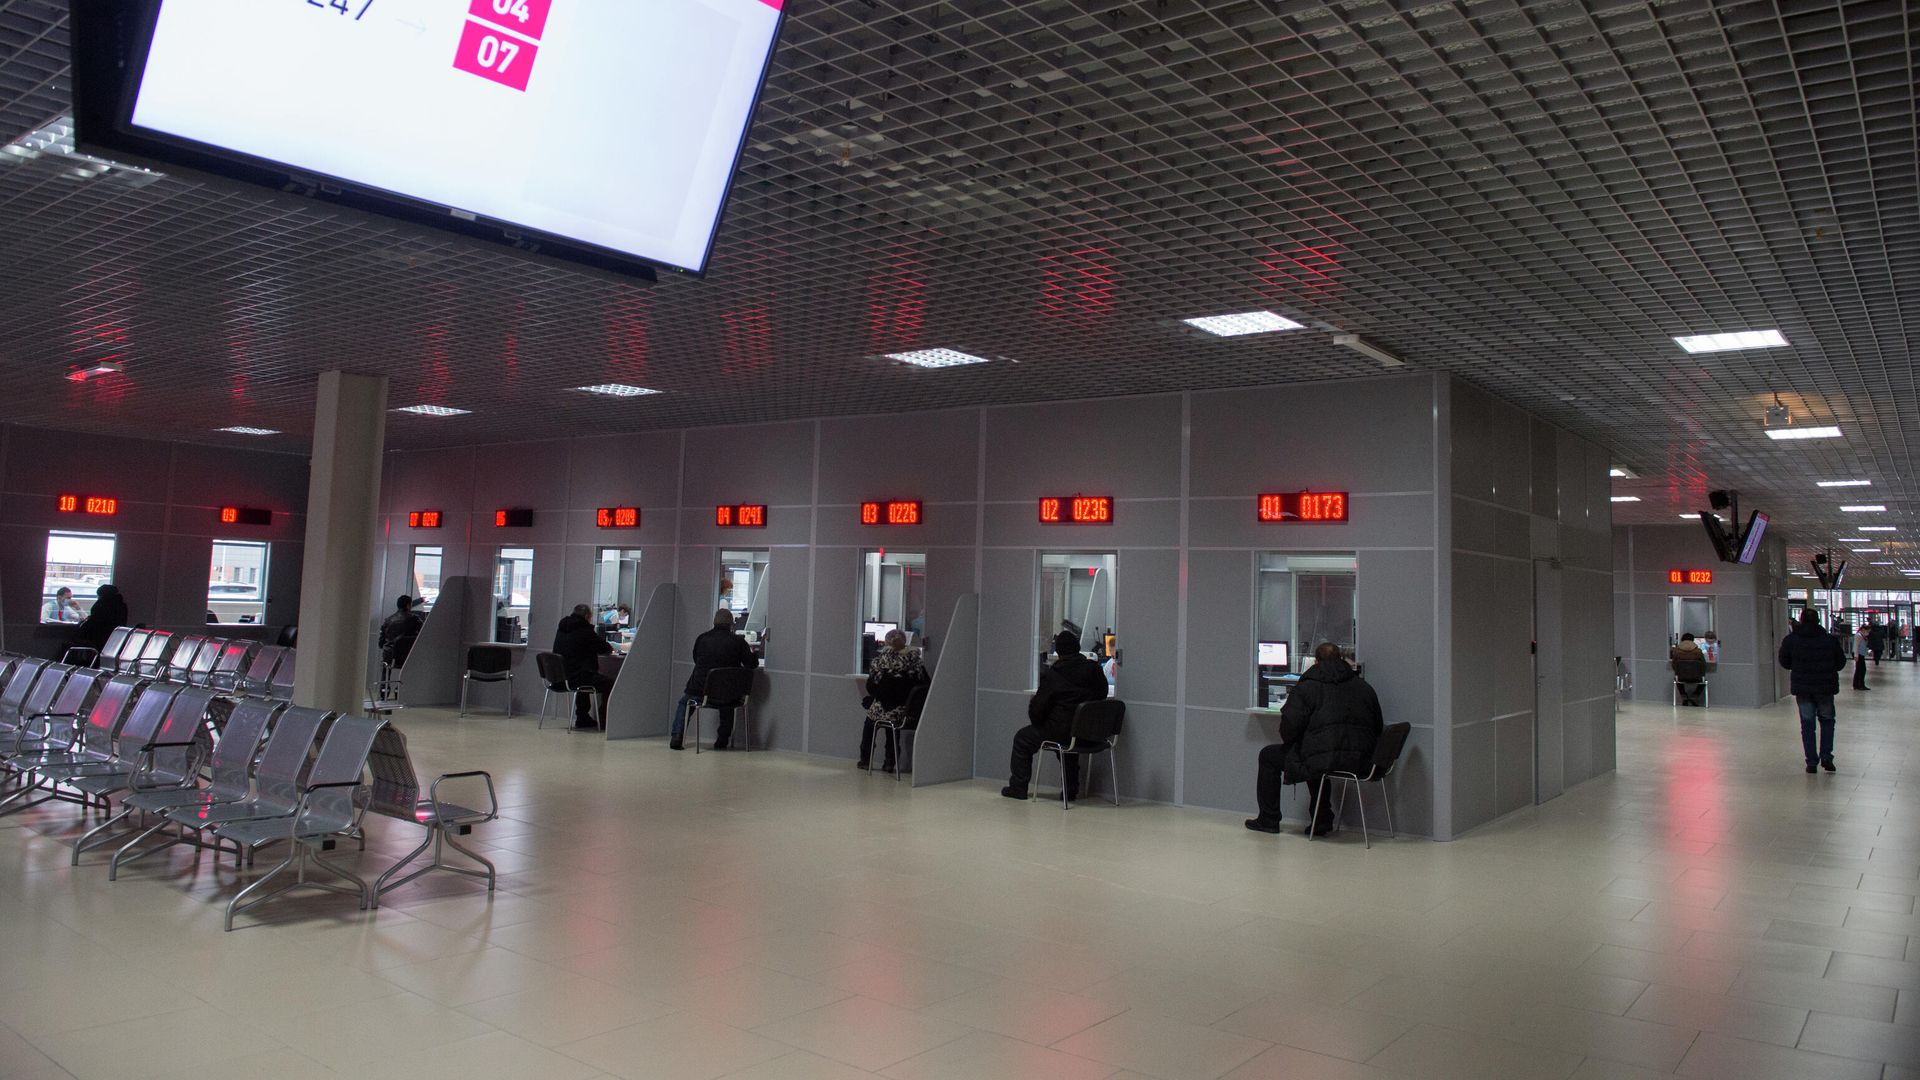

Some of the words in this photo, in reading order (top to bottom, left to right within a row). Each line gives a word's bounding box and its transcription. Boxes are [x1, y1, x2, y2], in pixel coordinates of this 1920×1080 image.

[477, 35, 519, 74] 07
[60, 496, 75, 511] 10
[87, 498, 115, 514] 0210
[863, 503, 877, 523] 03
[889, 503, 917, 523] 0226
[1042, 499, 1059, 520] 02
[1074, 499, 1108, 520] 0236
[1262, 496, 1281, 519] 01
[1302, 495, 1342, 519] 0173
[223, 508, 236, 522] 09
[718, 507, 729, 525] 04
[739, 506, 762, 525] 0241
[1671, 571, 1682, 583] 01
[1690, 571, 1711, 583] 0232
